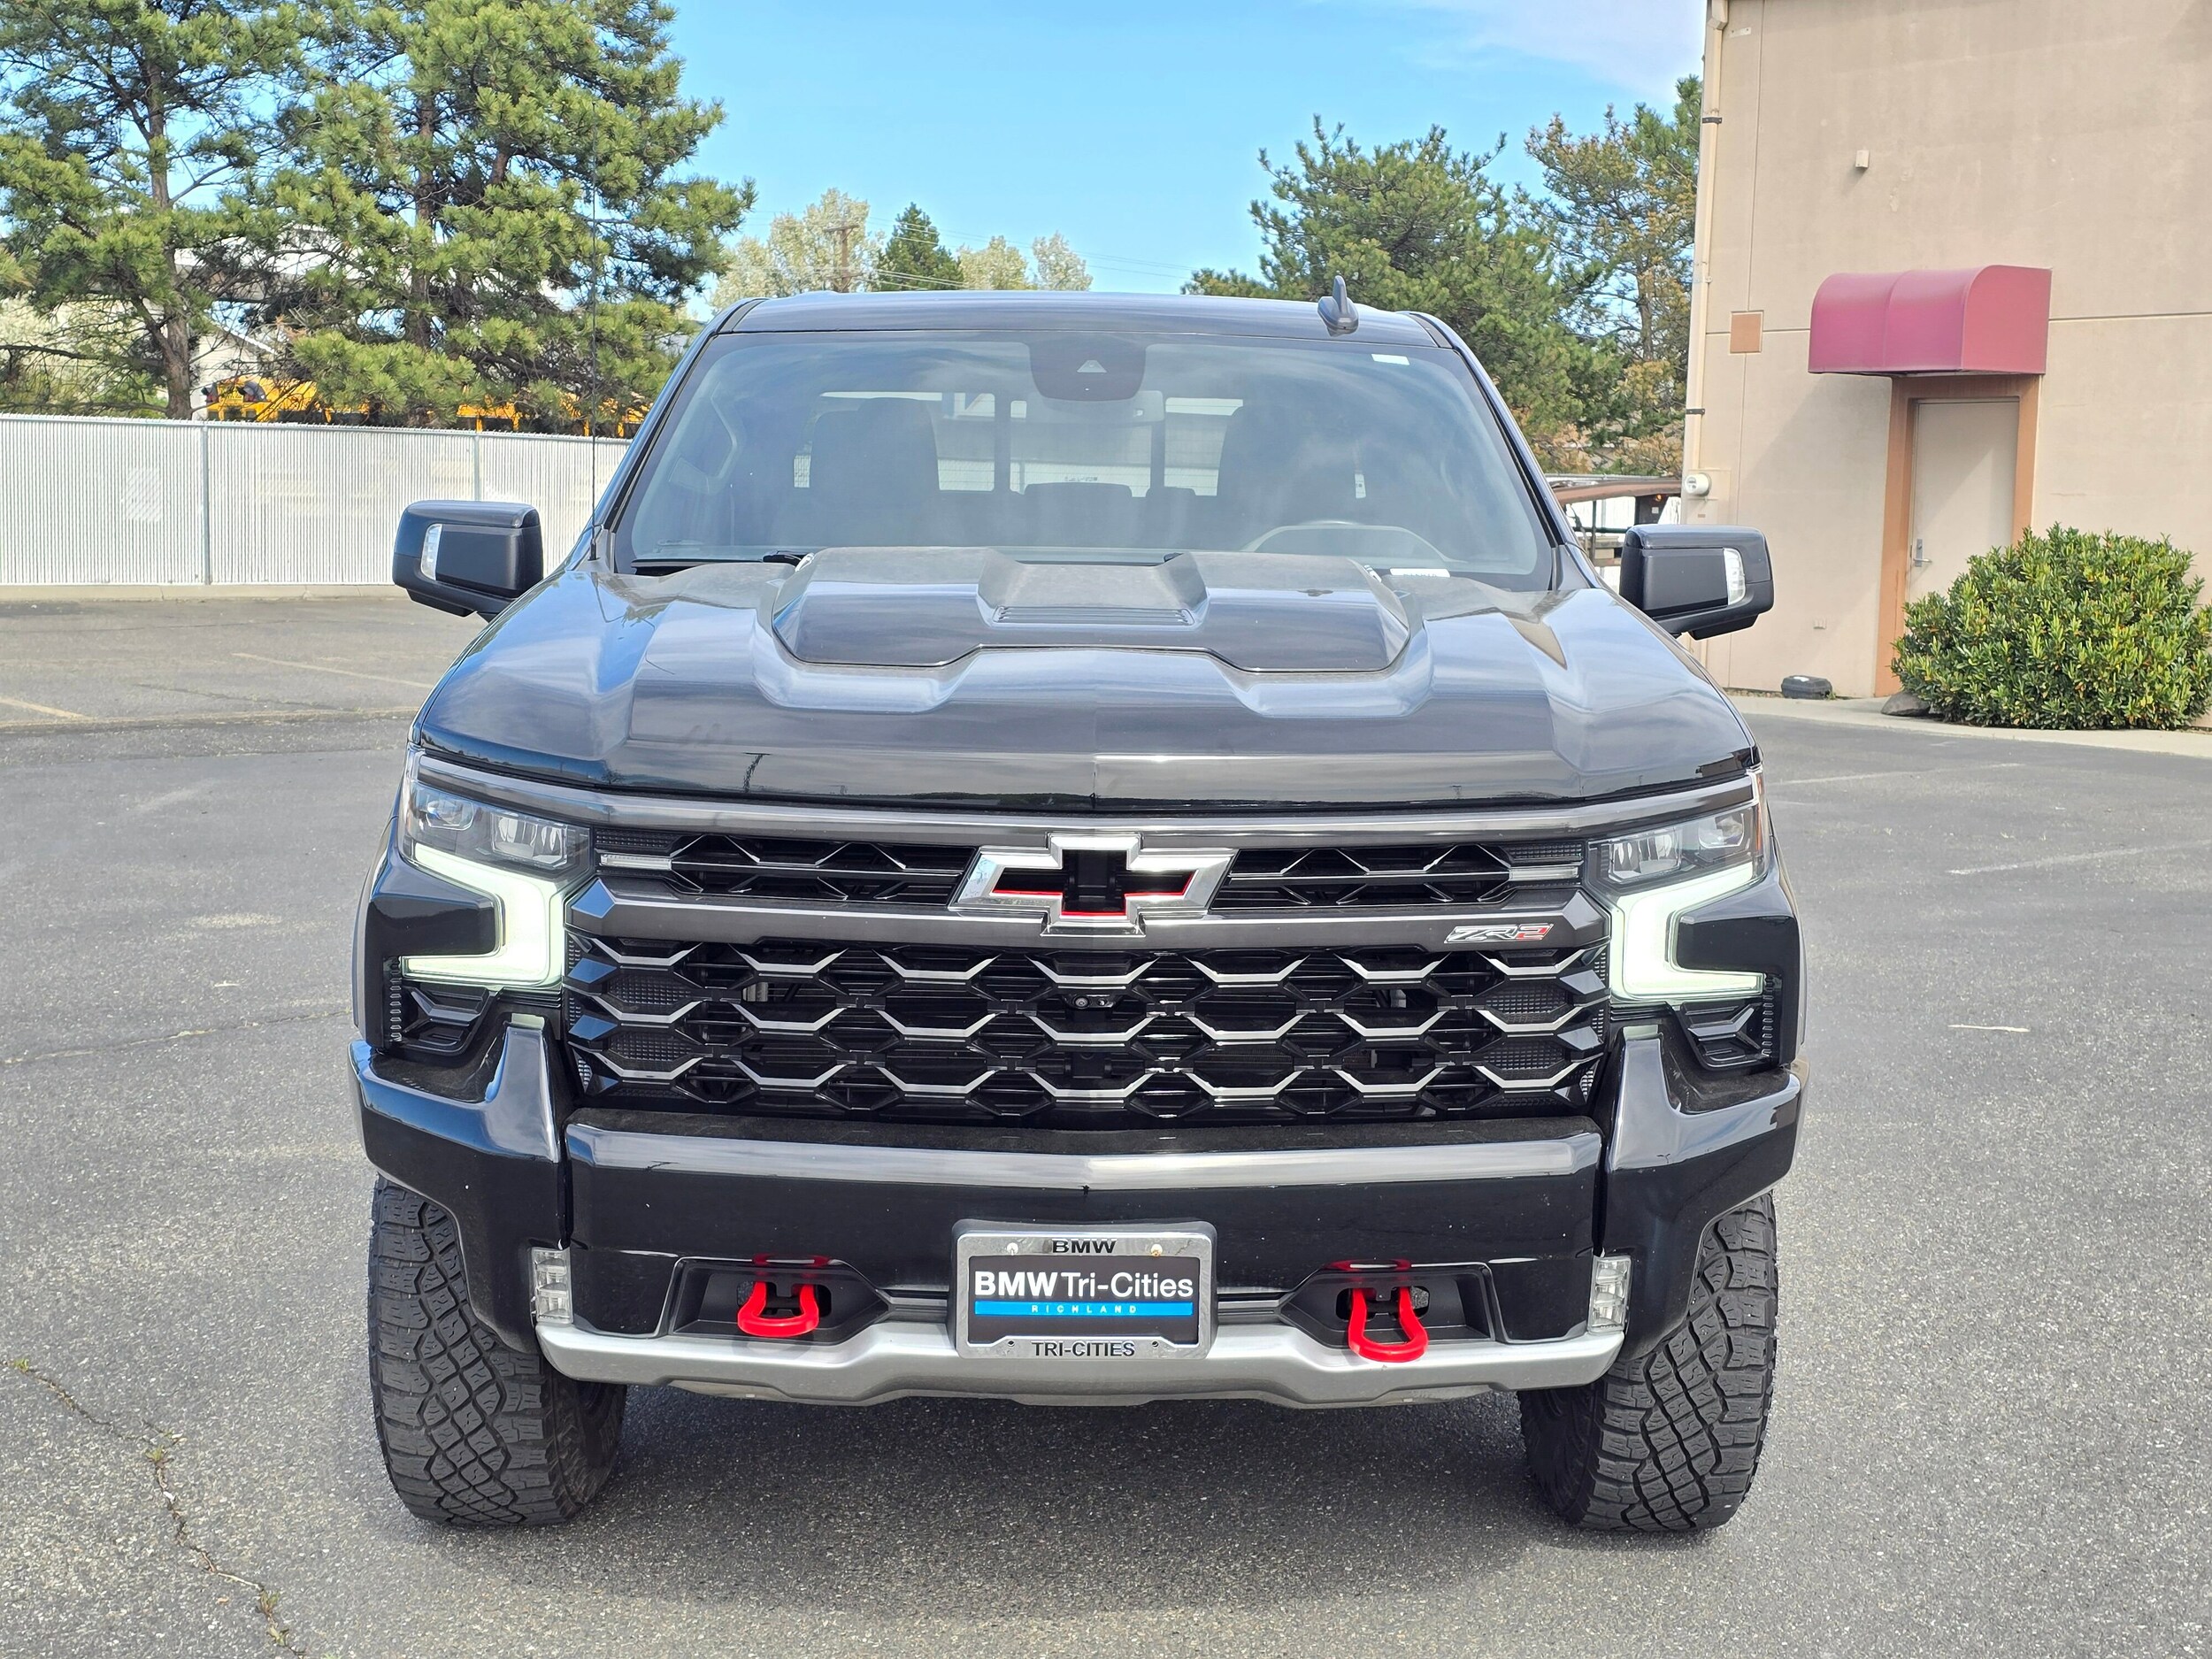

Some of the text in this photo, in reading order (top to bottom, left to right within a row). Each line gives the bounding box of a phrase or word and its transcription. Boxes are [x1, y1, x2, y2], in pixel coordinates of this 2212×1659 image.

[1444, 923, 1554, 944] ZR2
[1052, 1239, 1118, 1254] BMW
[975, 1271, 1194, 1298] BMW Tri-Cities
[1032, 1304, 1137, 1314] RICHLAND
[1032, 1340, 1135, 1356] TRI-CITIES
